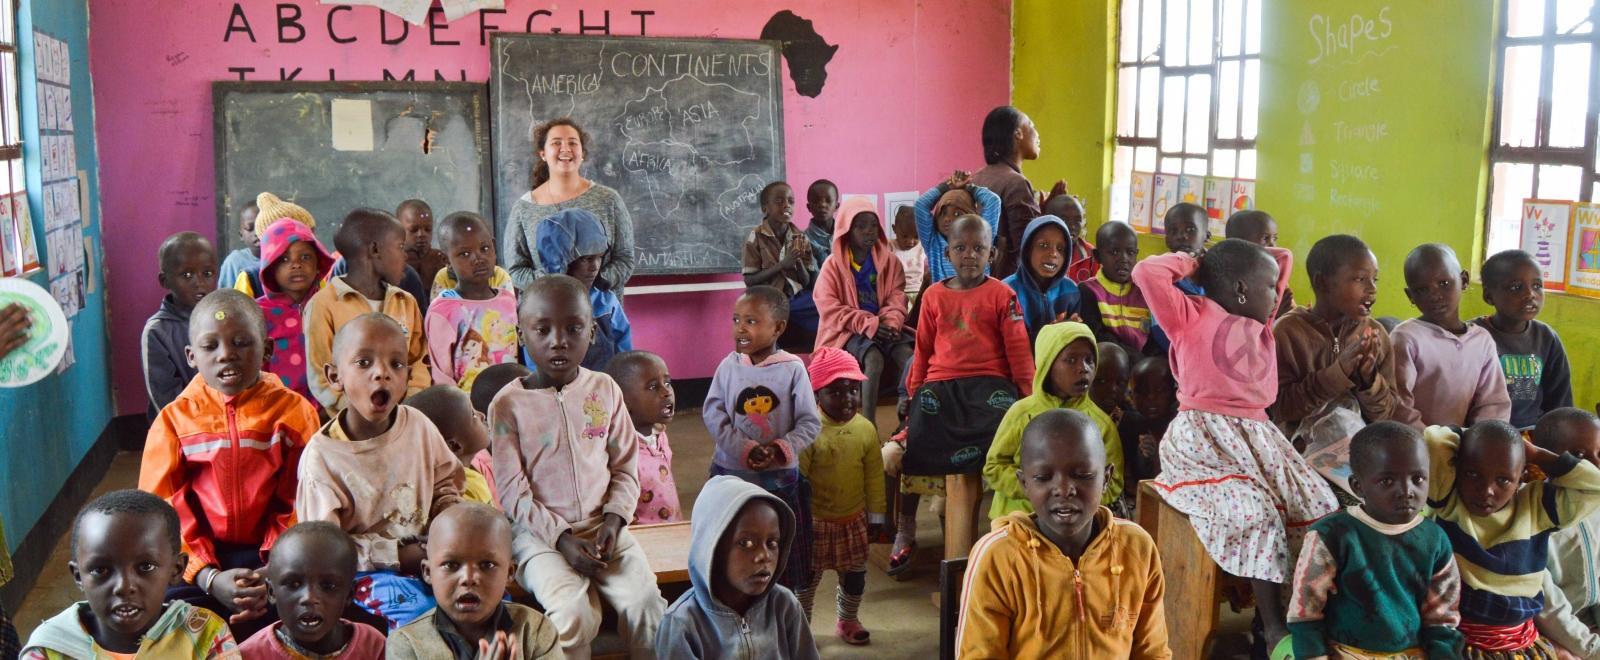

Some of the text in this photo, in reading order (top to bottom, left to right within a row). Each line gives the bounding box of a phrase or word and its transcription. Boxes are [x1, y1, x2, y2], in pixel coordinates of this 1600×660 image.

[1307, 6, 1392, 64] Shapes
[611, 52, 770, 77] CONTINENTS
[532, 73, 598, 95] AMERICA
[1339, 77, 1380, 101] Circle
[682, 100, 720, 127] ASIA
[1332, 121, 1389, 144] Triangle
[629, 151, 671, 172] AFRICA
[1329, 159, 1381, 184] Square
[1526, 205, 1543, 220] Vv
